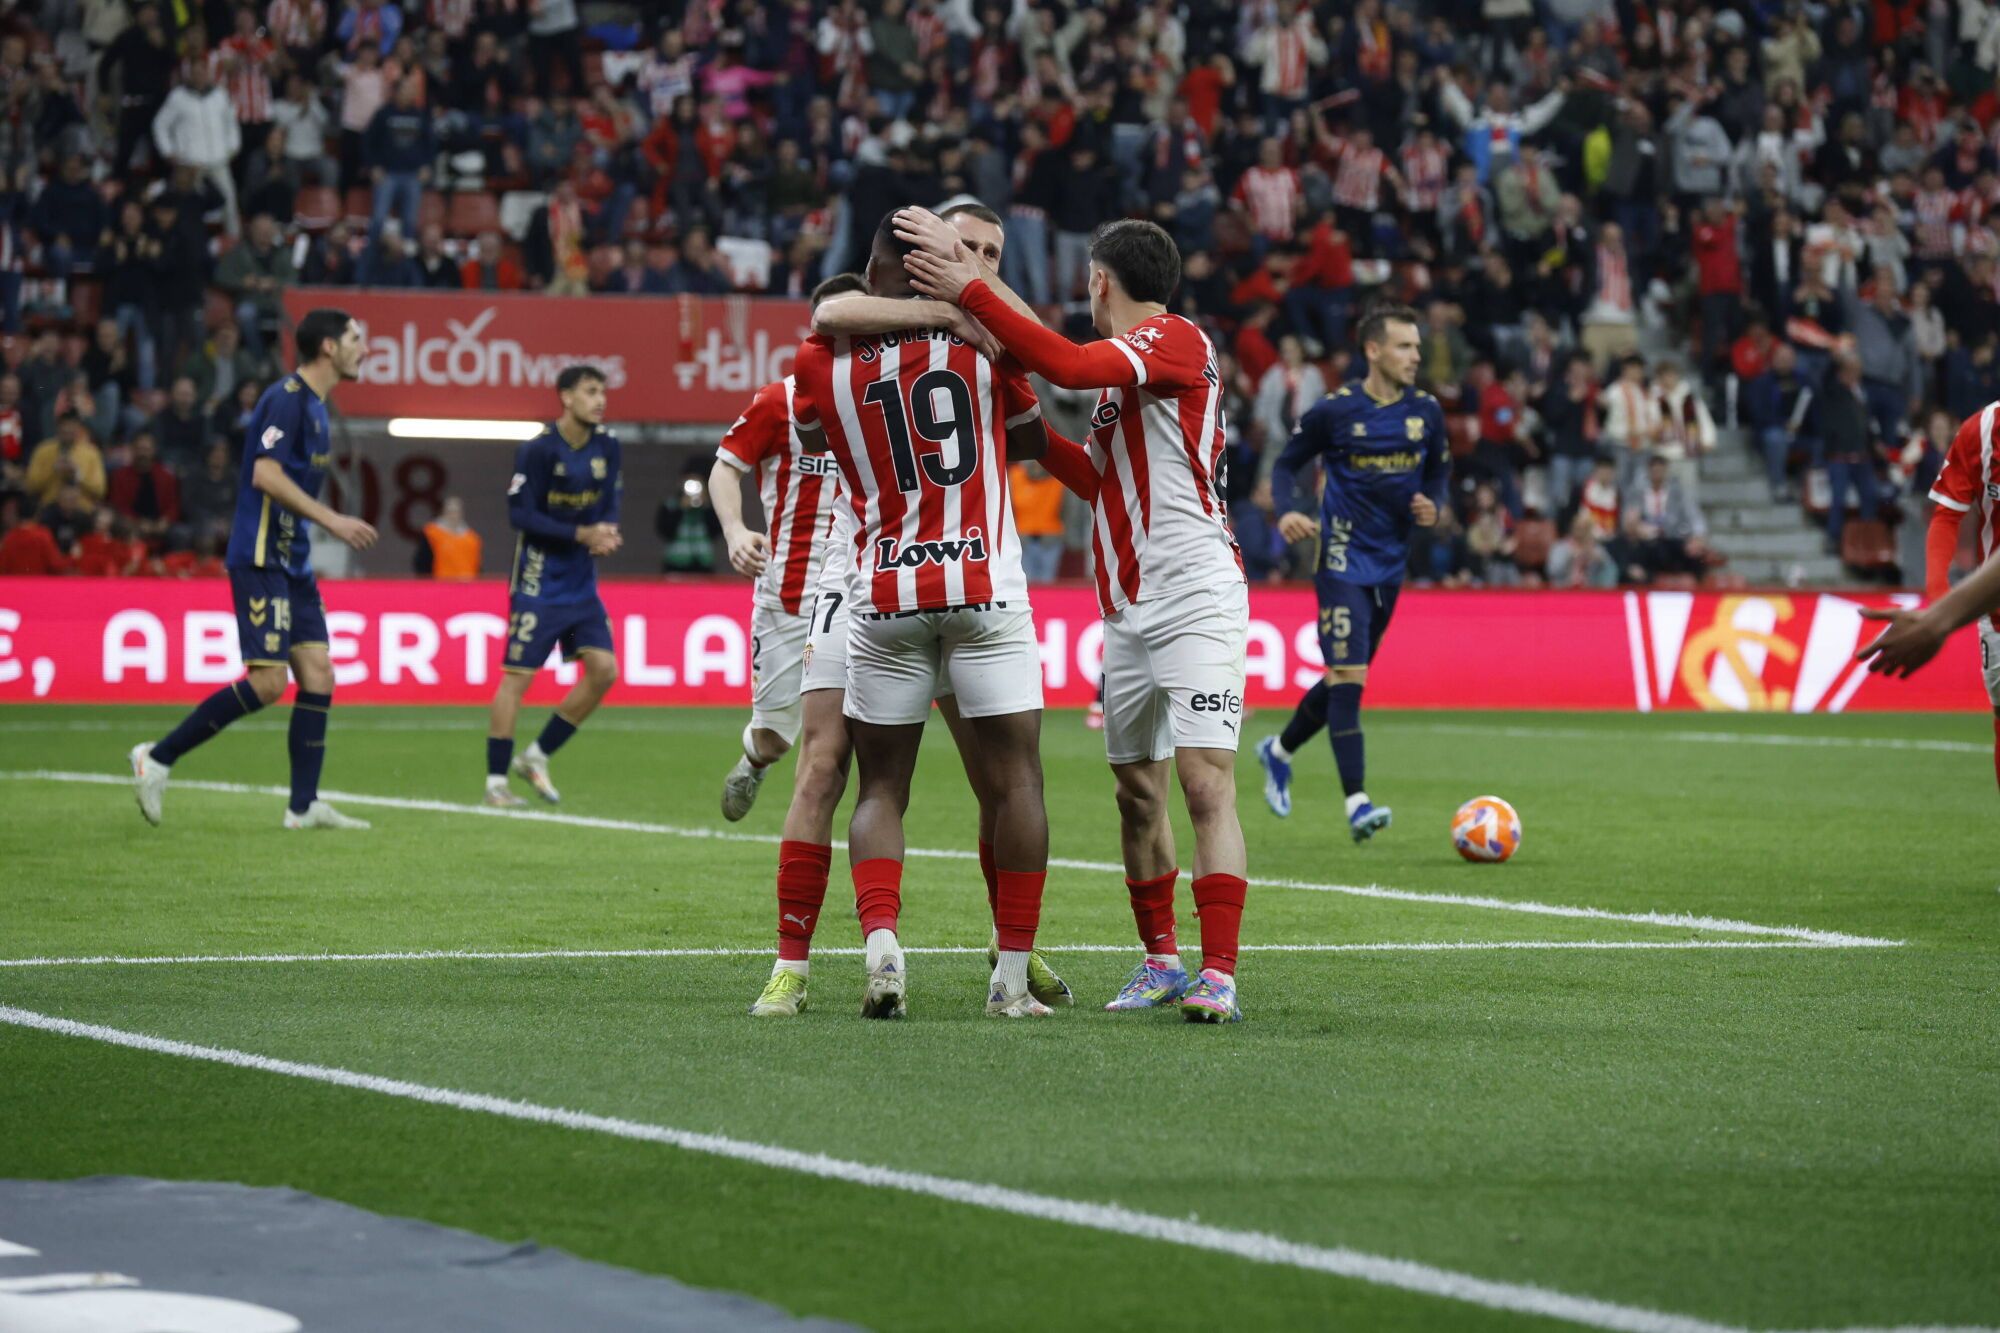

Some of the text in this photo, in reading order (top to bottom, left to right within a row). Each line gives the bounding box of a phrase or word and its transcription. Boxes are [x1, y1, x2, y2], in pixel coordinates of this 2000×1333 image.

[863, 369, 978, 494] 19
[877, 526, 987, 572] Lowi
[1332, 606, 1351, 639] 5
